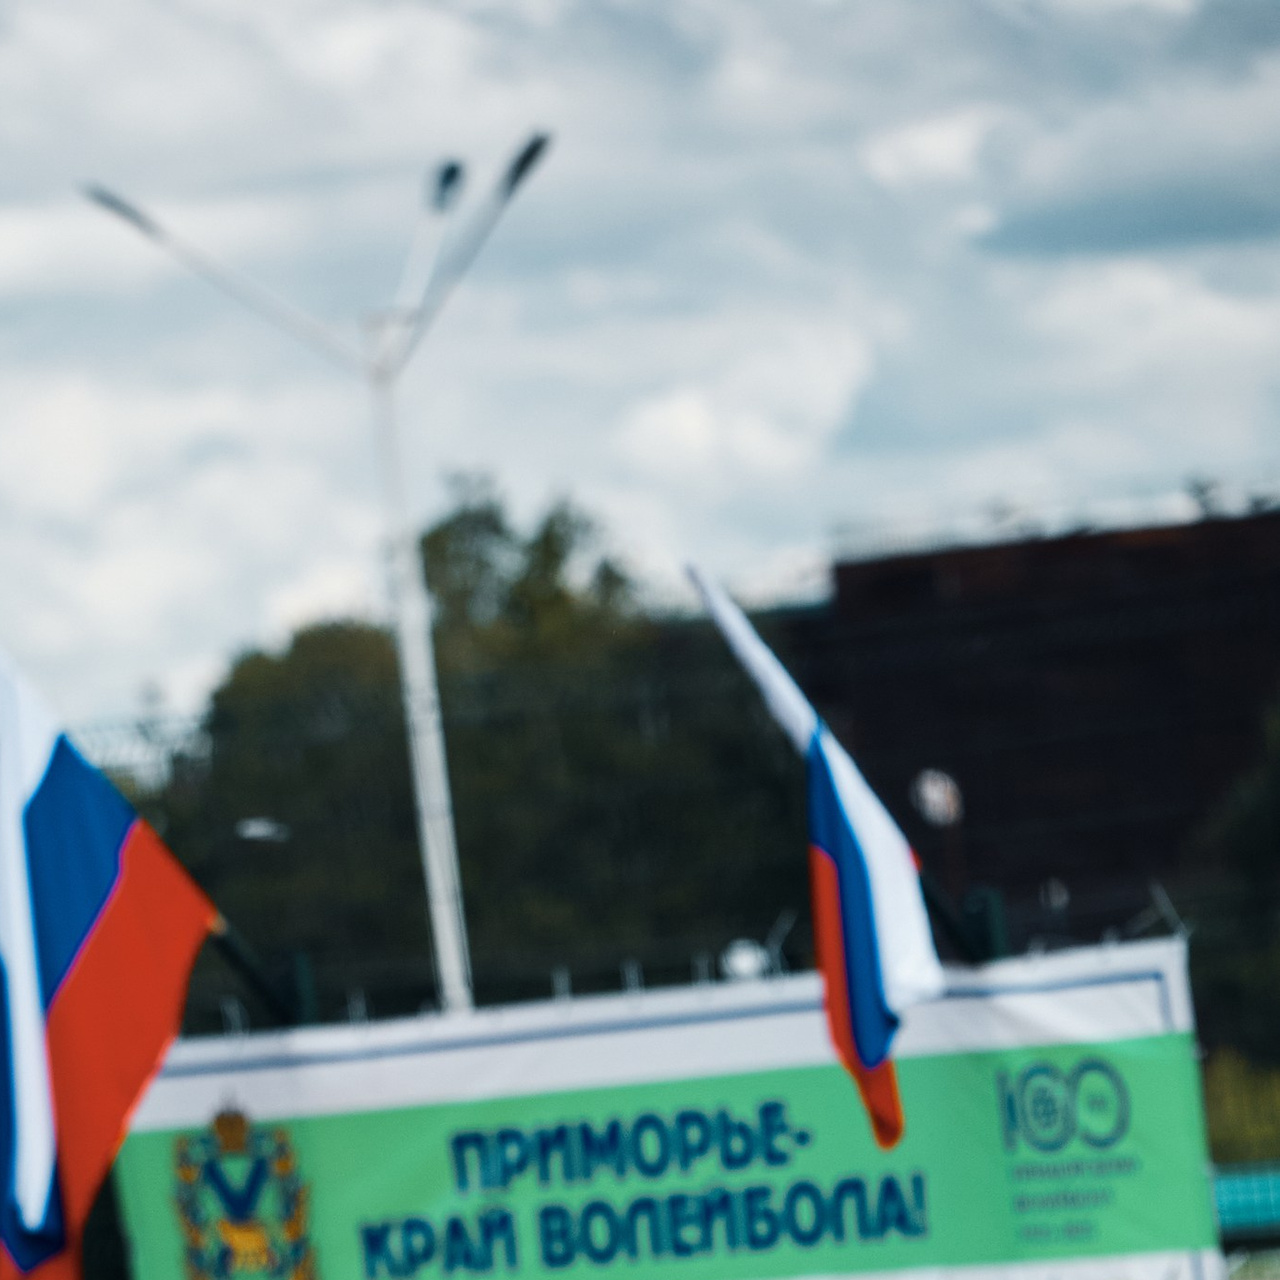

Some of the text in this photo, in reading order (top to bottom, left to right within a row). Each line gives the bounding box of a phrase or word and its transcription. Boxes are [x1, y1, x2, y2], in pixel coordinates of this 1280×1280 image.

[450, 1099, 812, 1193] ПРИМОРЬЕ-
[360, 1171, 928, 1280] КРАЙ ВОЛЕЙБОЛА!
